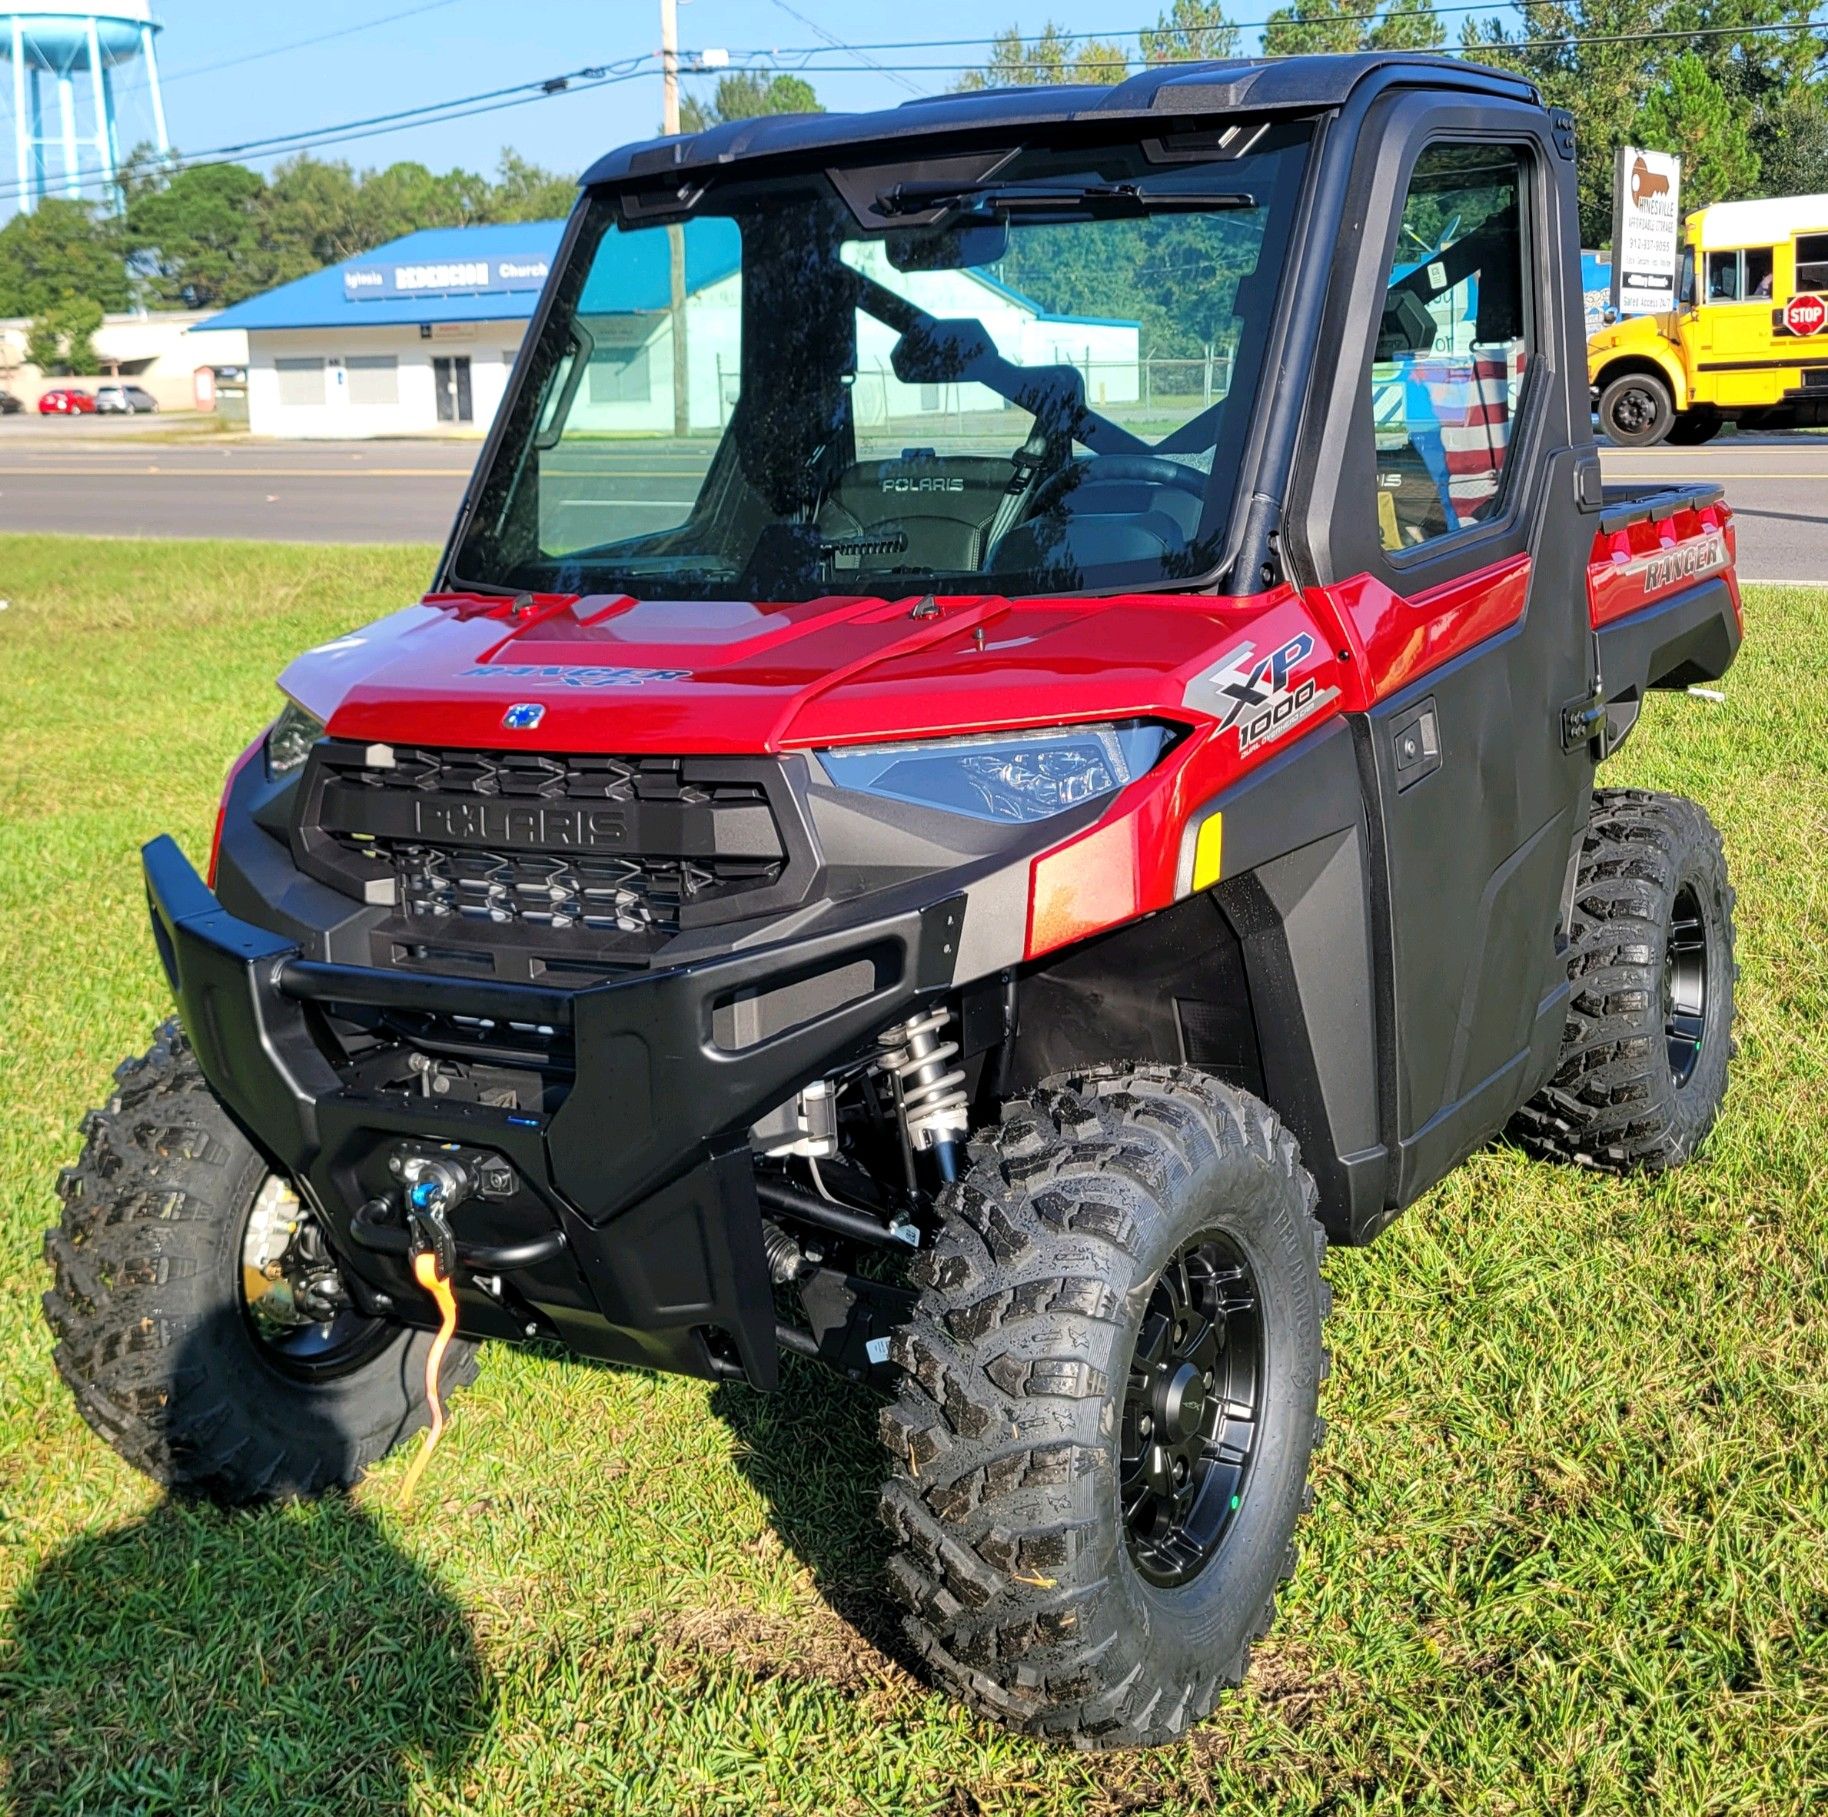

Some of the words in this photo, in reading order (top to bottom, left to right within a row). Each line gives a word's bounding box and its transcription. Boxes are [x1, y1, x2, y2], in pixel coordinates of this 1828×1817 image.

[499, 262, 549, 279] Church
[1790, 306, 1822, 323] STOP
[882, 477, 964, 492] POLARIS
[1644, 537, 1719, 594] RANGER
[1208, 631, 1315, 742] XP
[1239, 678, 1315, 752] 1000
[415, 800, 630, 846] POLARIS
